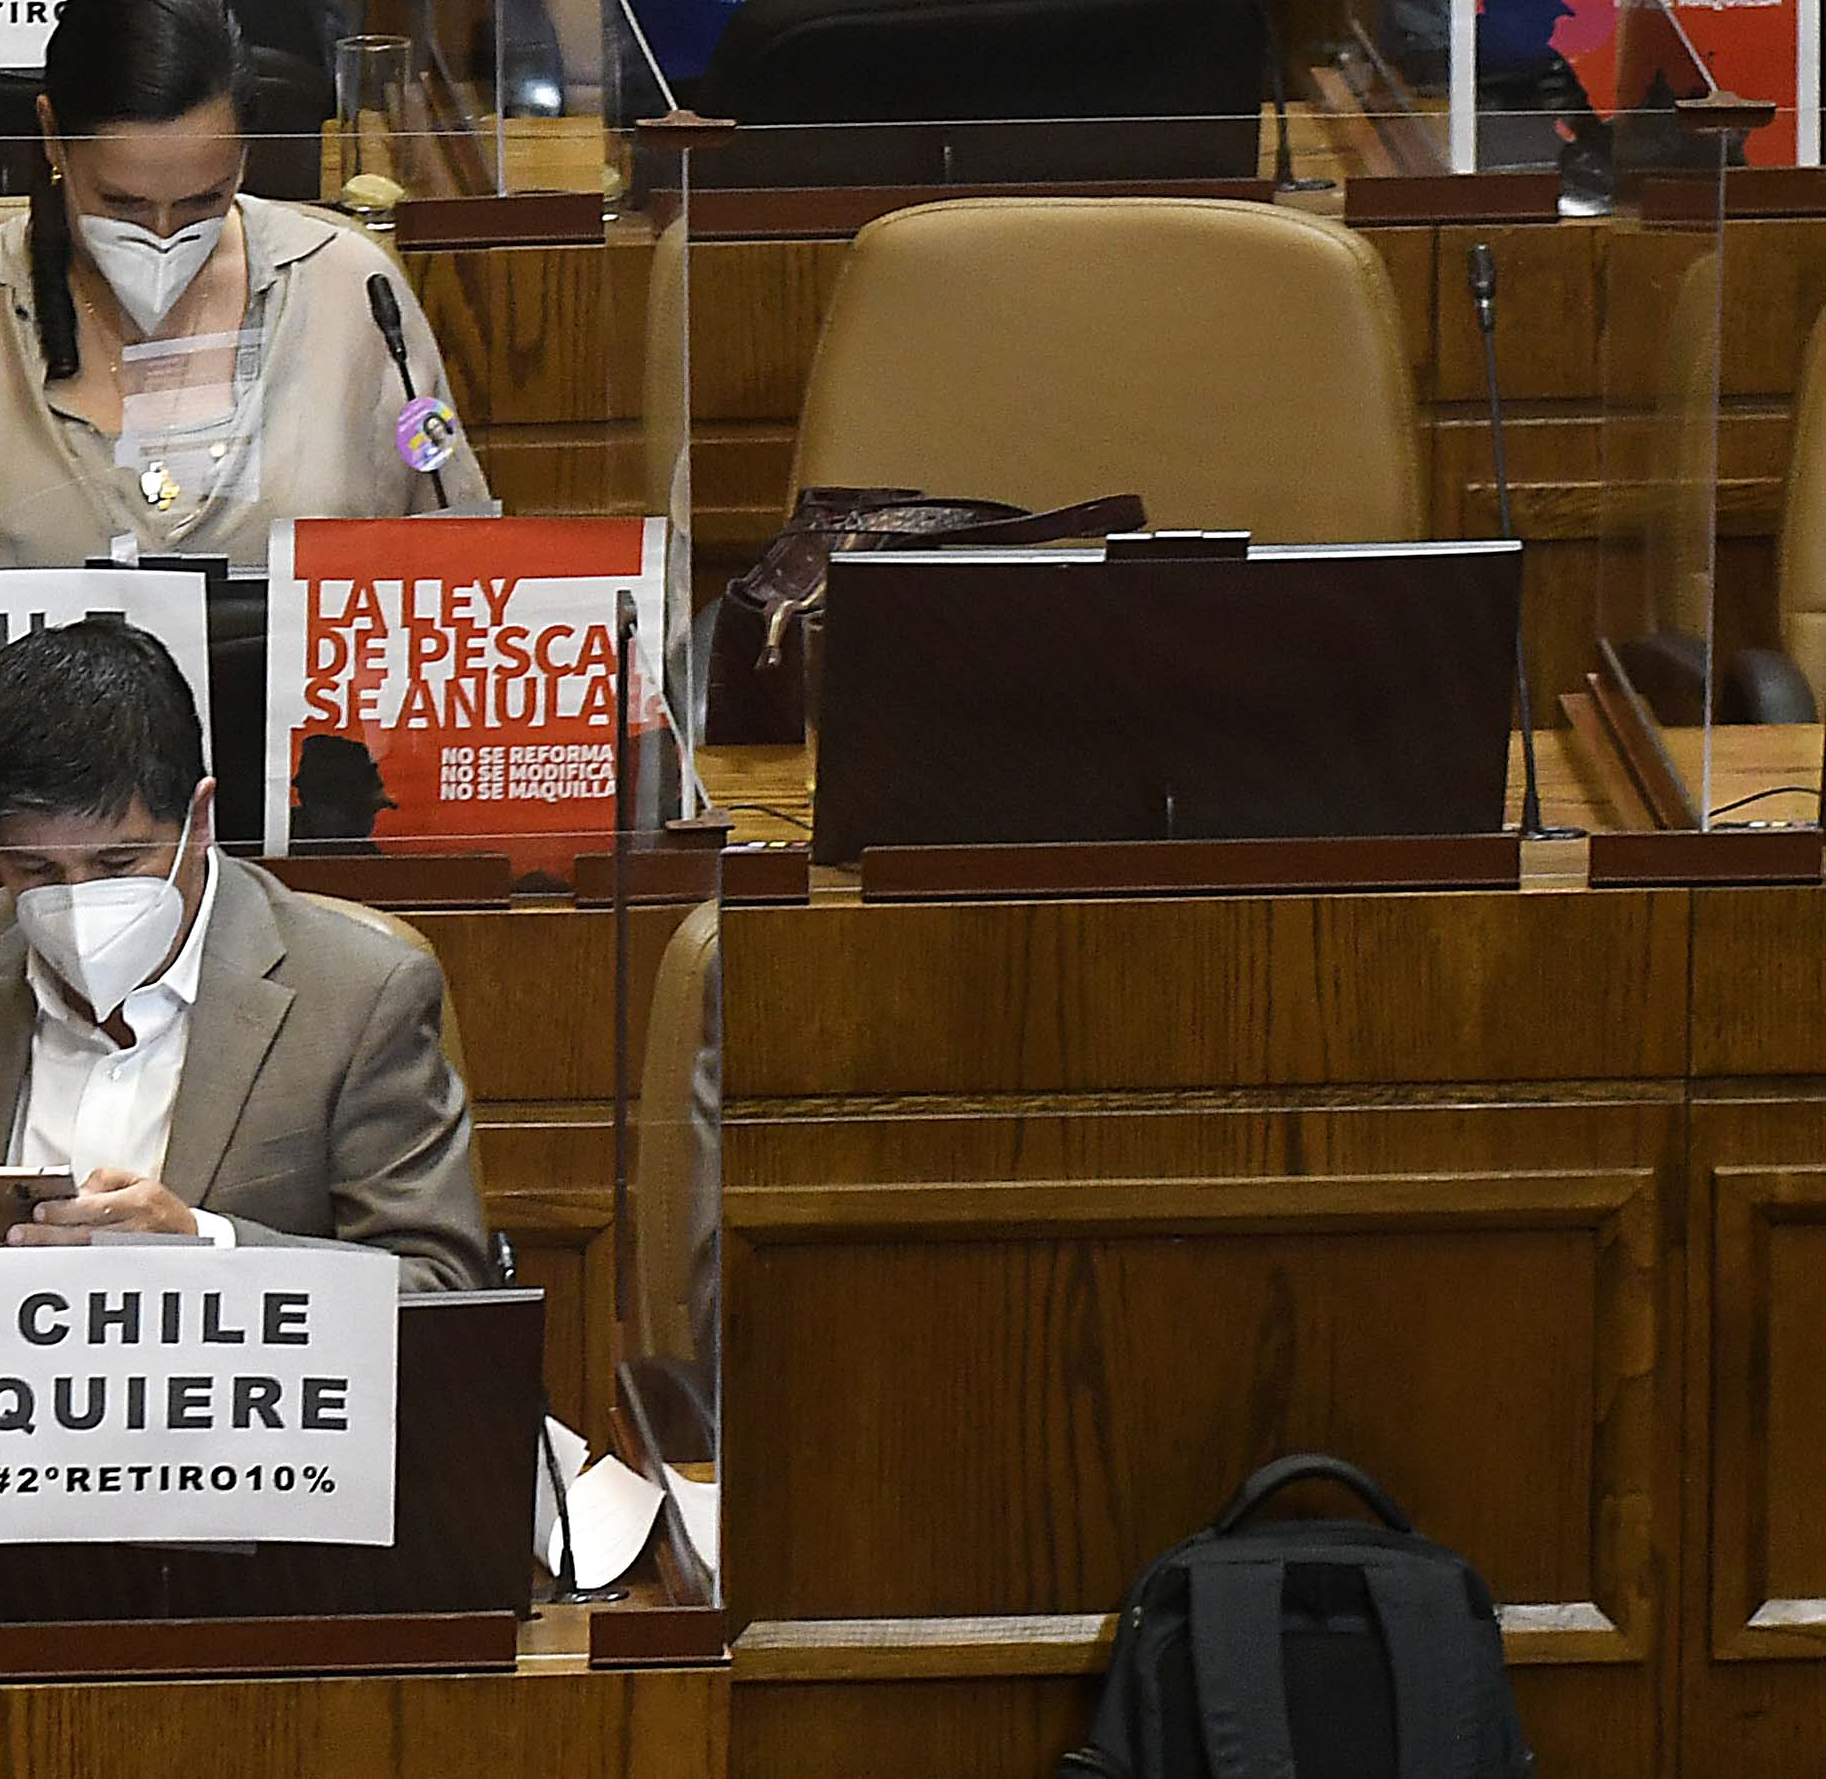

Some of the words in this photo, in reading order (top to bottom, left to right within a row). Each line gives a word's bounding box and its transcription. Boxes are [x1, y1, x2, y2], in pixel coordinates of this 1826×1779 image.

[307, 579, 388, 631] LA
[401, 578, 520, 627] LEY
[306, 625, 389, 679] DE
[407, 623, 616, 678] PESCA
[304, 678, 382, 728] SE
[398, 675, 618, 729] ANULA
[441, 765, 474, 782] NO
[478, 765, 504, 782] SE
[509, 763, 614, 781] MODIFICA
[442, 747, 475, 765] NO
[479, 746, 505, 764] SE
[509, 744, 613, 763] REFORMA
[440, 783, 474, 800] NO
[477, 782, 504, 800] SE
[509, 780, 616, 803] MAQUILLA
[19, 1292, 309, 1345] CHILE
